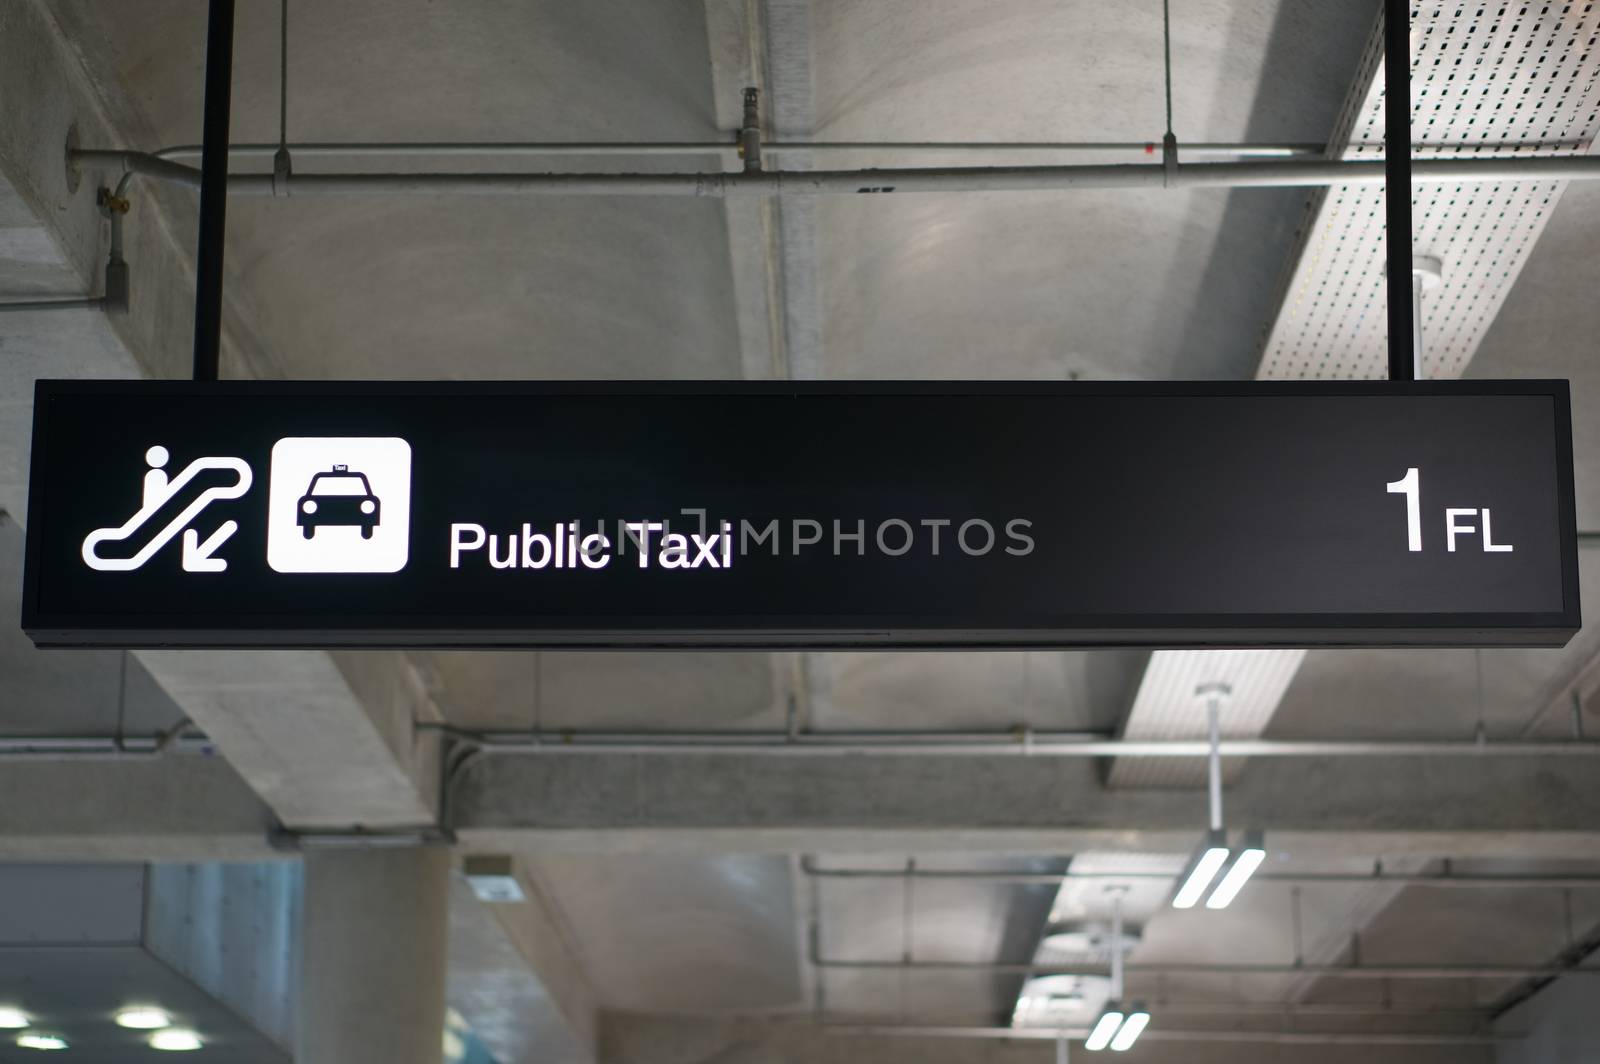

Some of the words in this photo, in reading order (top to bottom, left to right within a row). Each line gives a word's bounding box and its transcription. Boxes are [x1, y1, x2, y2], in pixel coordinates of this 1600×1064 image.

[1386, 467, 1422, 552] 1
[1446, 507, 1513, 553] FL
[450, 523, 611, 569] Public
[626, 522, 732, 569] Taxi
